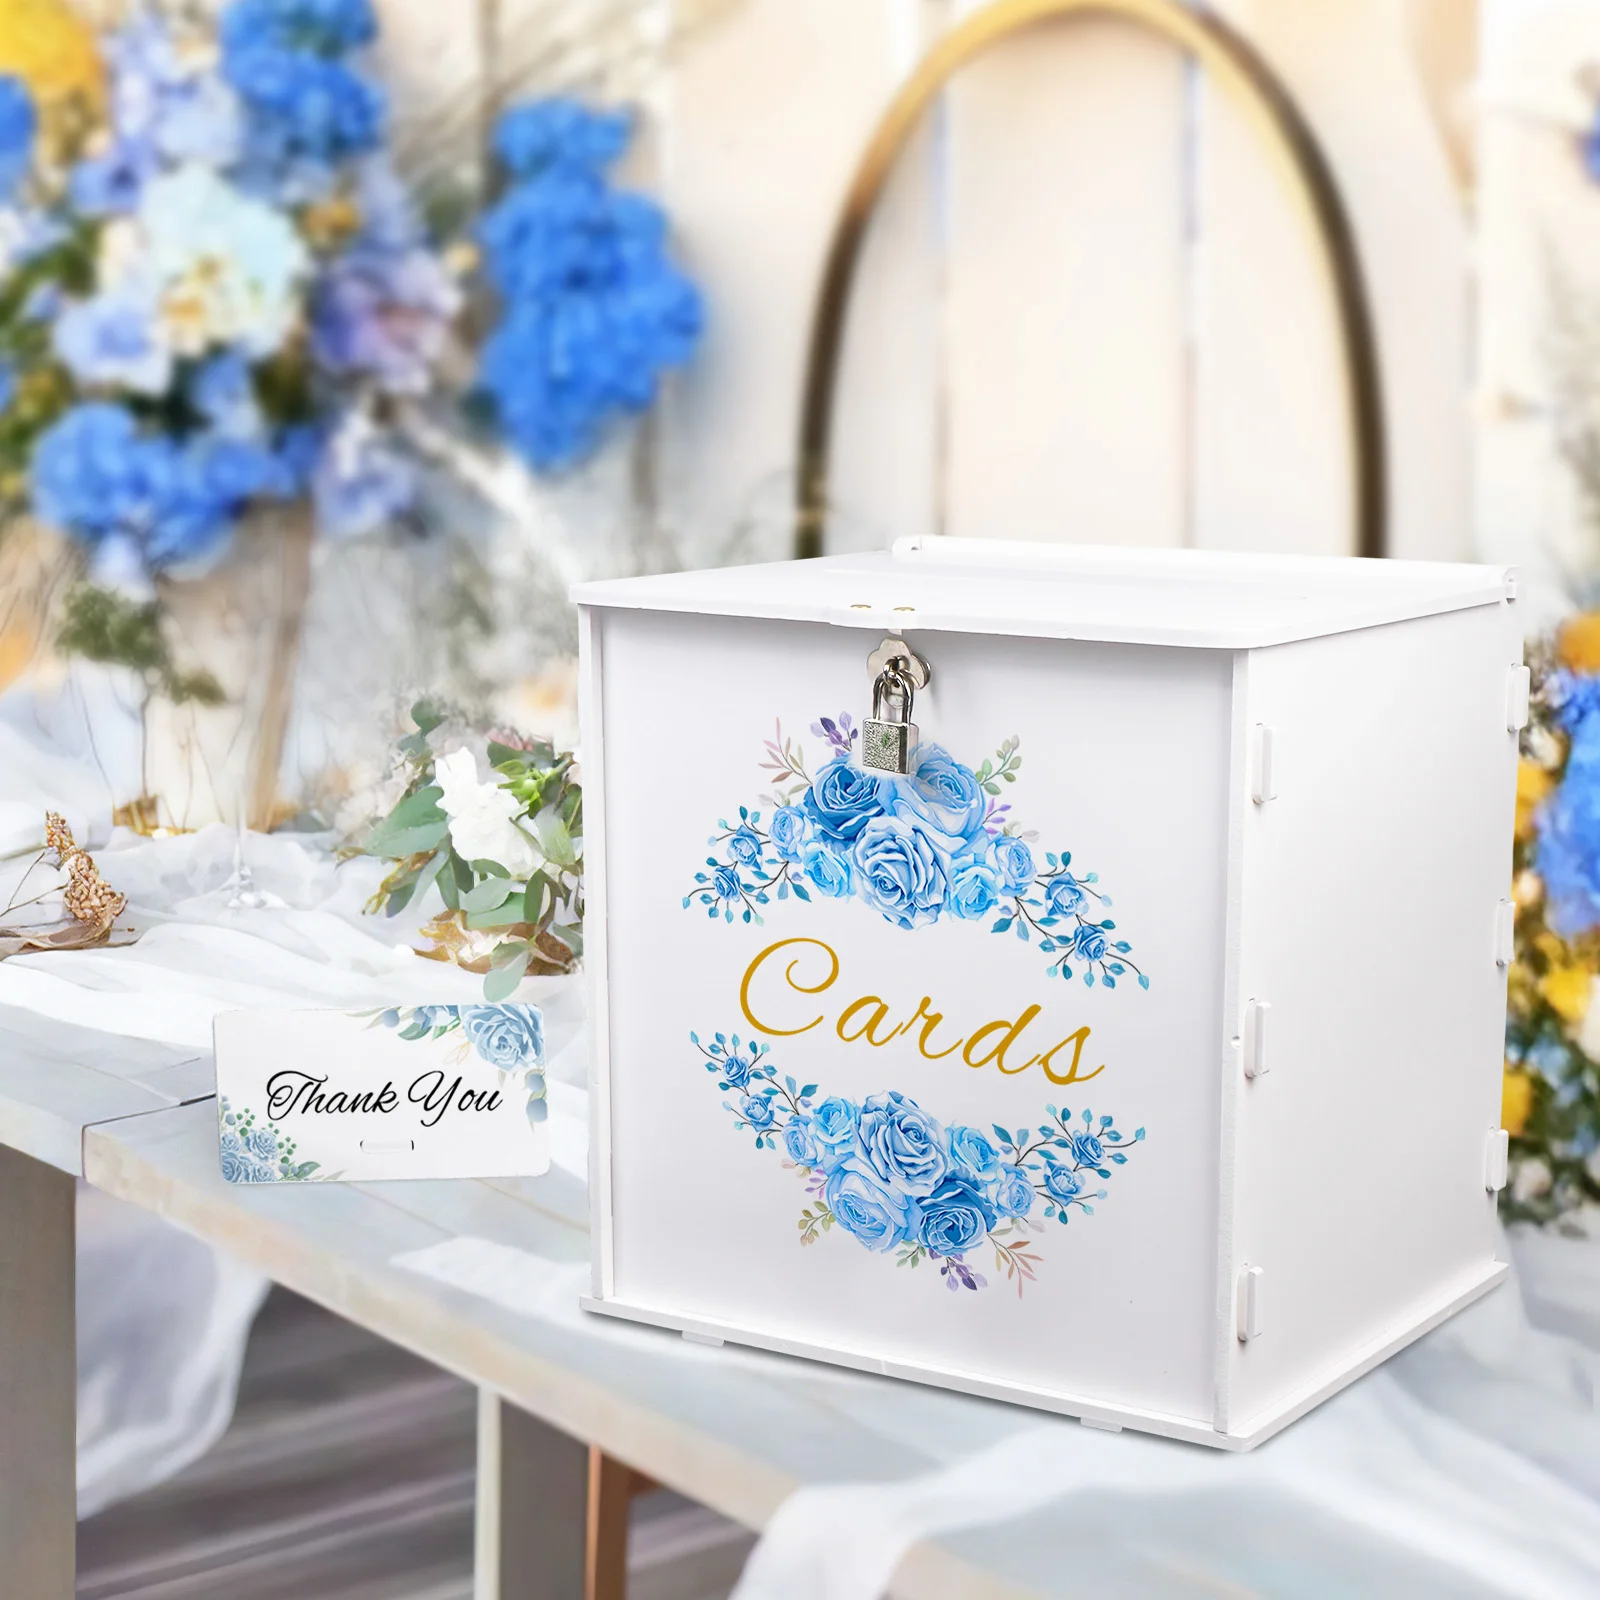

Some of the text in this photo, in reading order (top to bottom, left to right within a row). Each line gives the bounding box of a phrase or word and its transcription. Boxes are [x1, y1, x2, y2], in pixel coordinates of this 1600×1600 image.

[739, 937, 1105, 1086] Cards
[266, 1070, 503, 1127] Thank You
